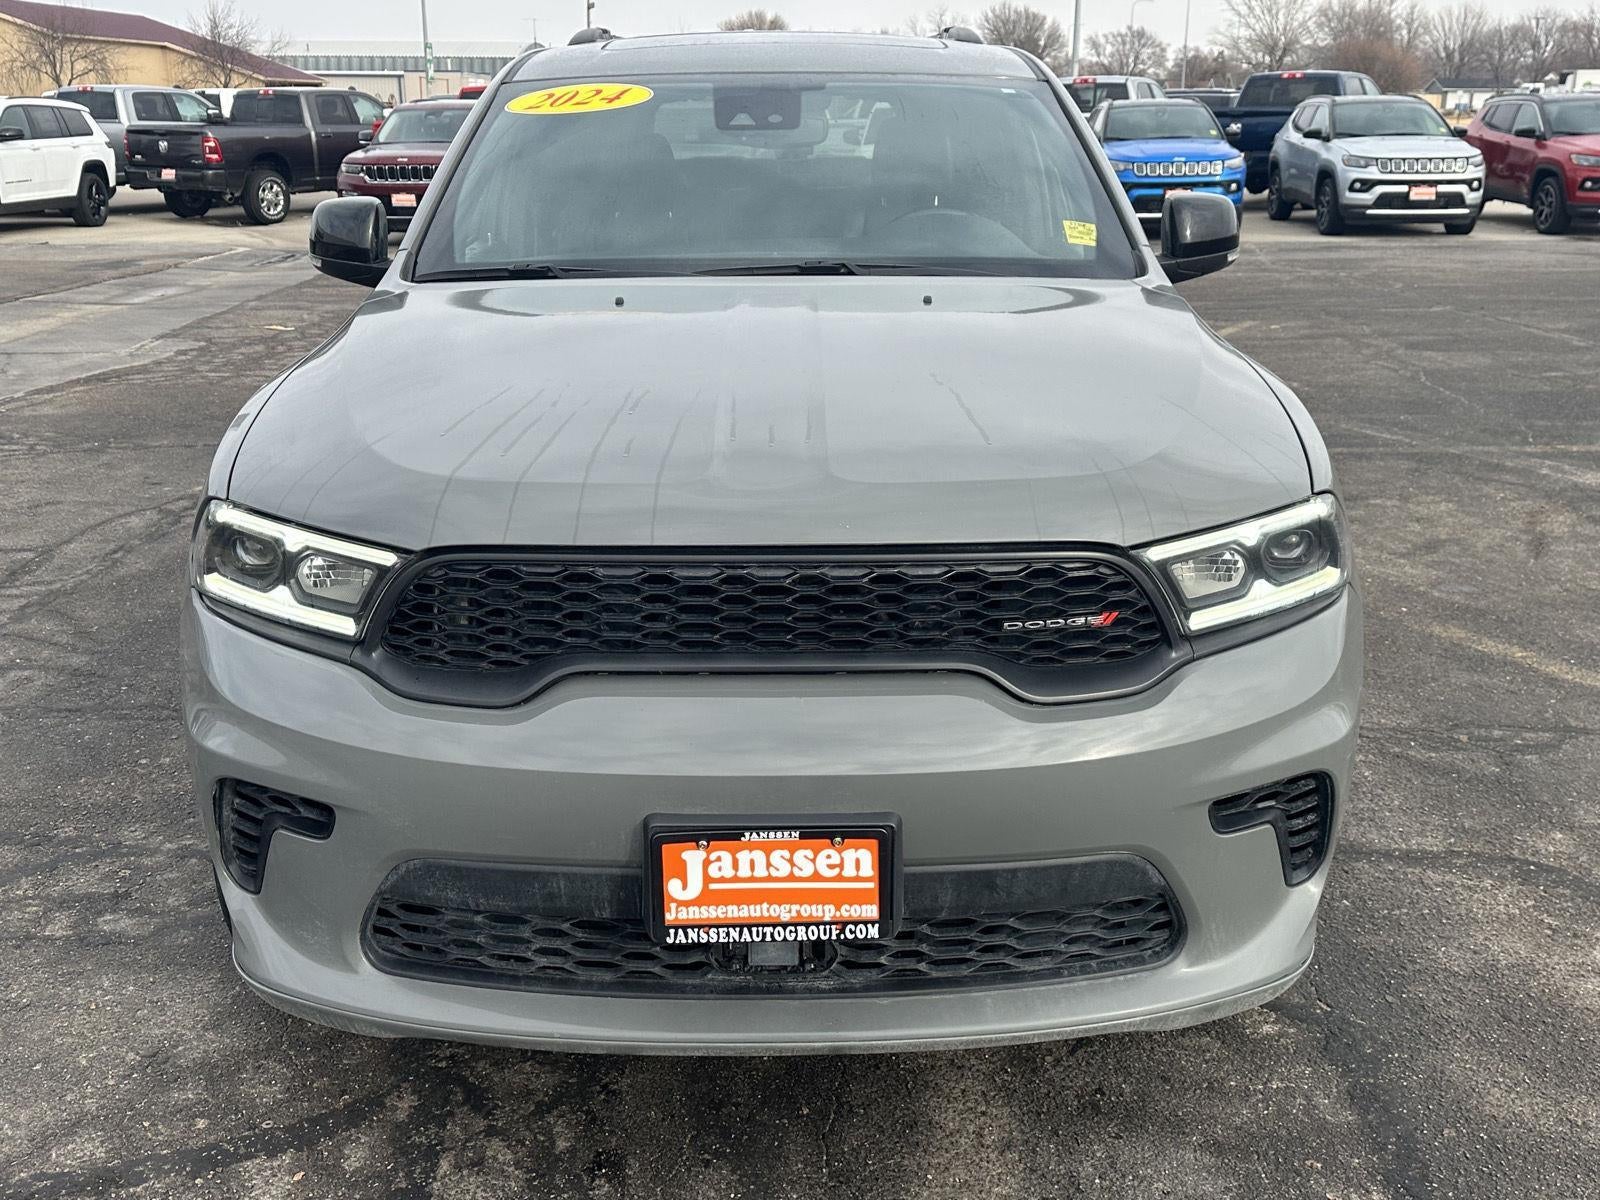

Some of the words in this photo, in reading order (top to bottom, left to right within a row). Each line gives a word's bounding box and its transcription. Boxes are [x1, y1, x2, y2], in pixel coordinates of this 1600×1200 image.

[523, 87, 633, 111] 2024
[1003, 615, 1104, 630] DODGE
[740, 831, 800, 842] JANSSEN
[667, 848, 875, 900] Janssen
[665, 902, 878, 922] Janssenautogroup.com
